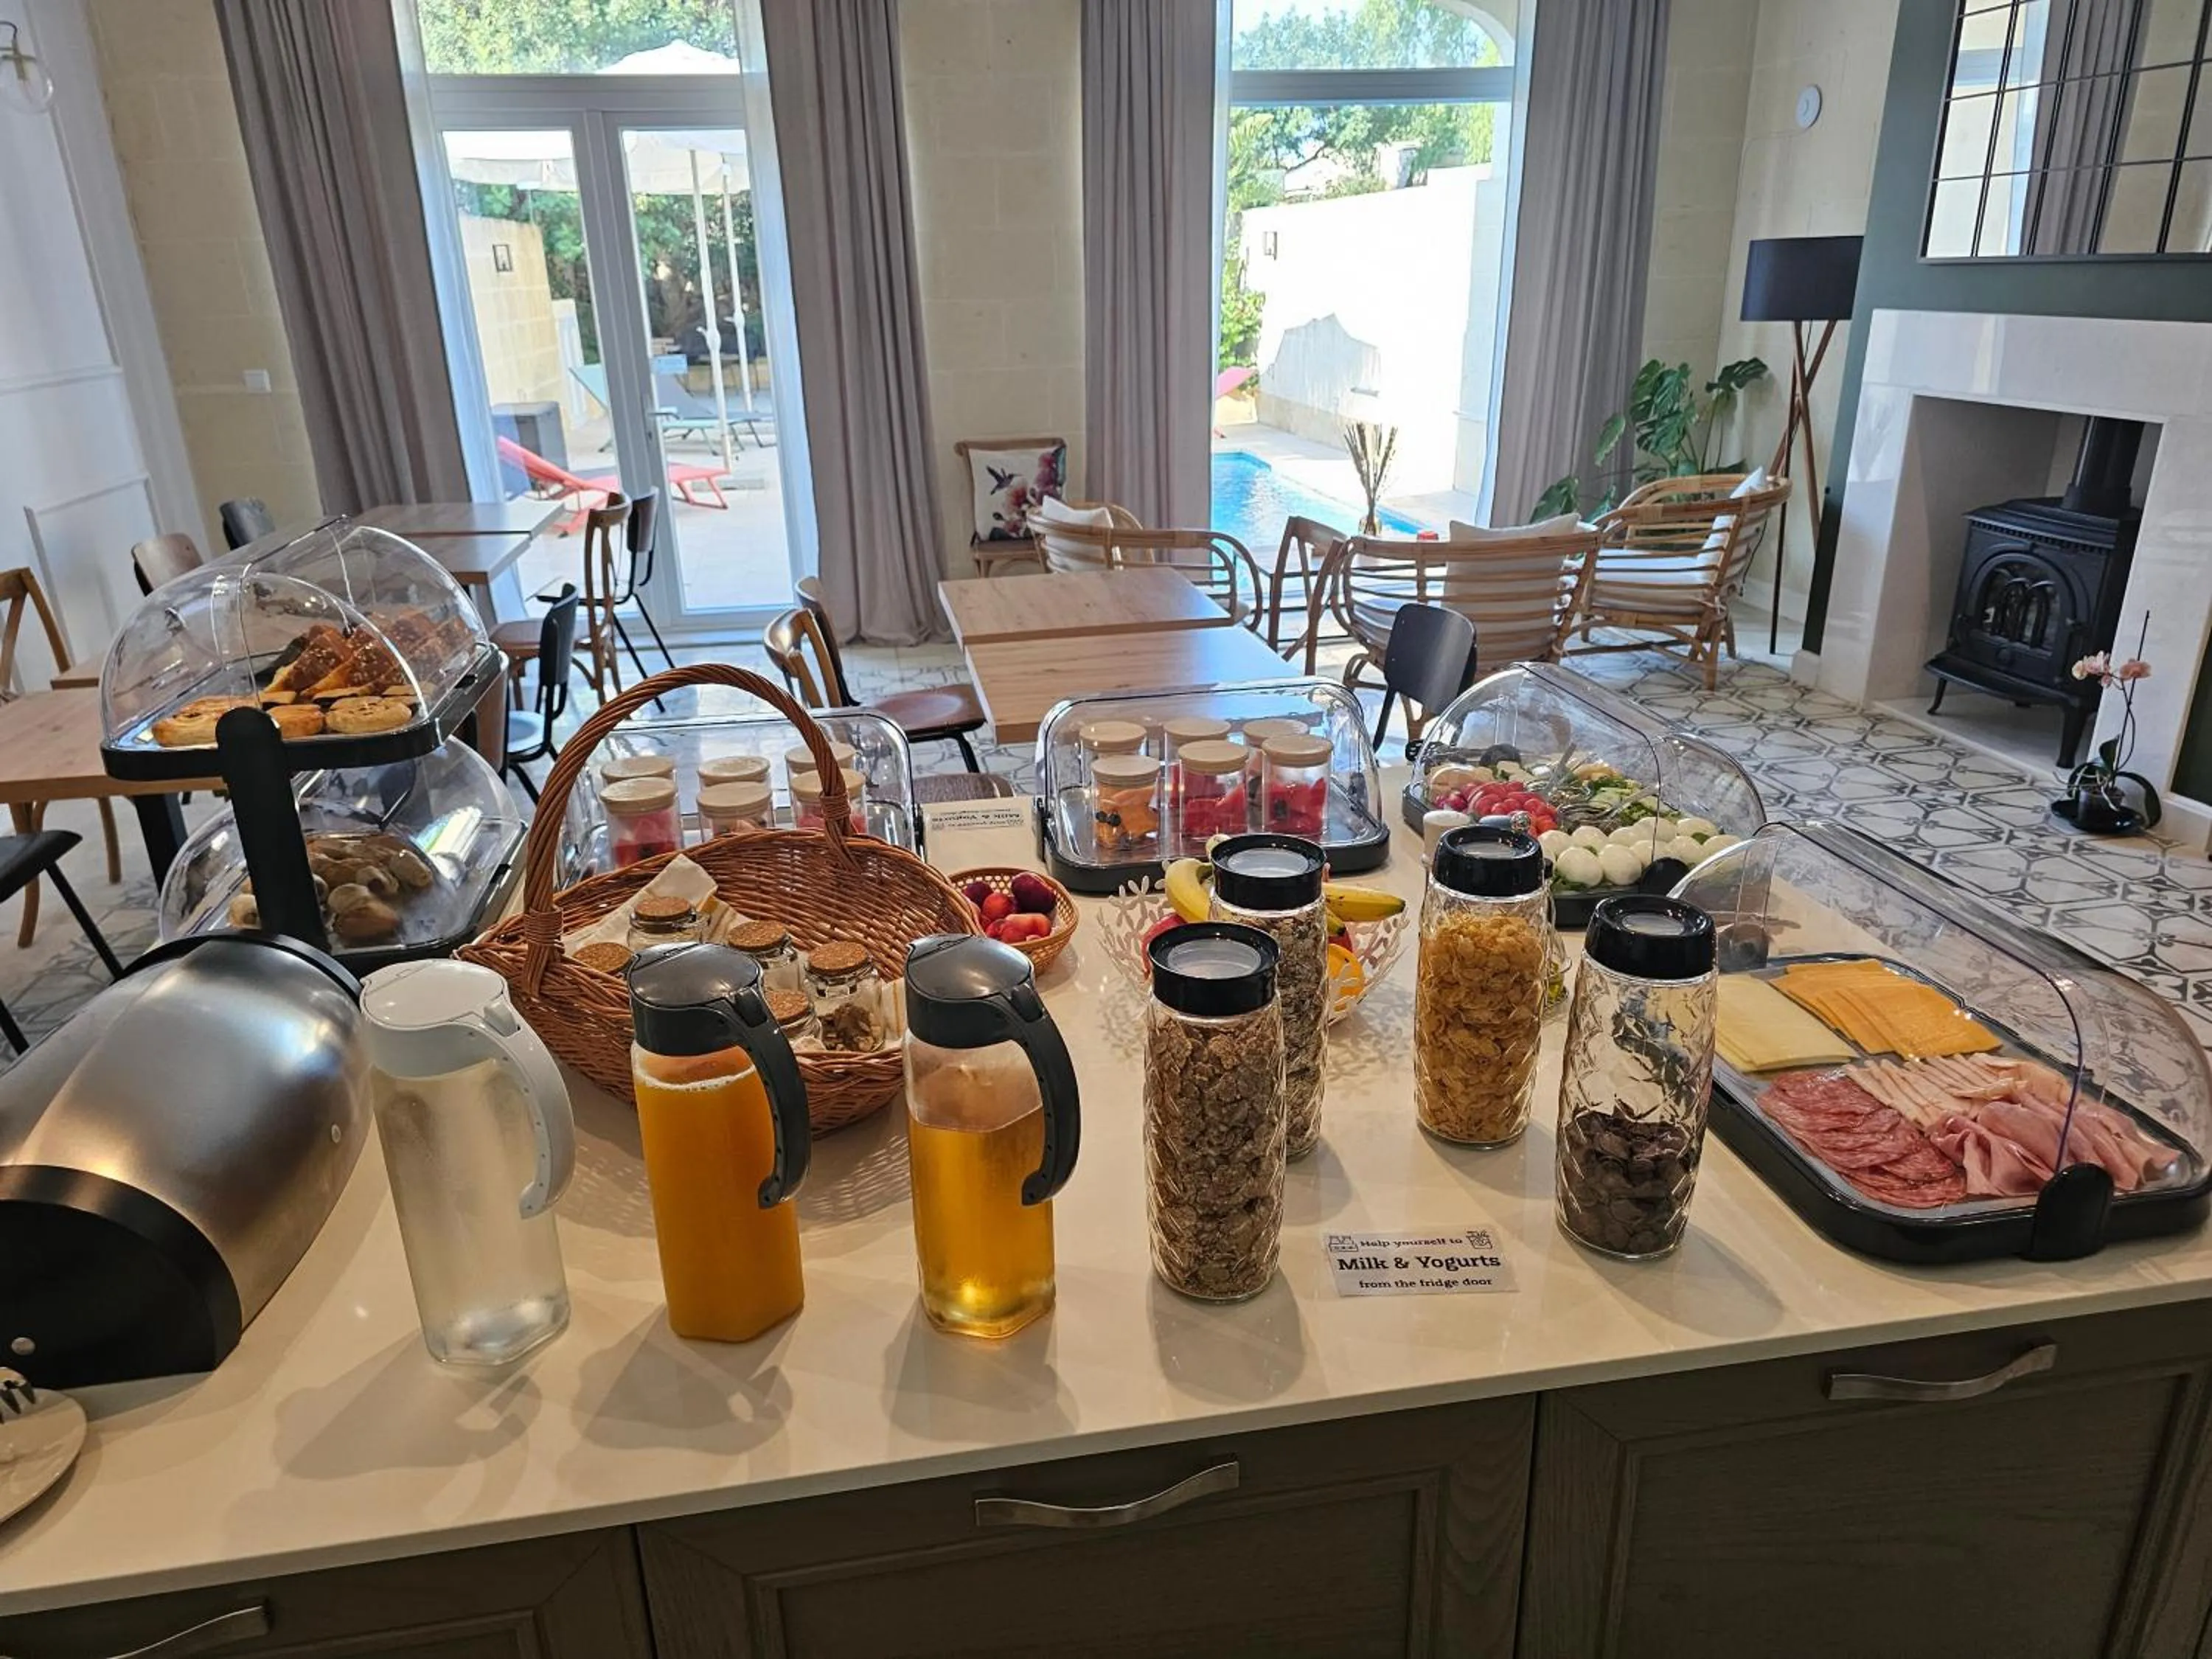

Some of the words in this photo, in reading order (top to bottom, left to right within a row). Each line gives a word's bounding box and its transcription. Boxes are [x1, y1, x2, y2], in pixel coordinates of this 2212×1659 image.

[1360, 1239, 1390, 1248] Help
[1394, 1238, 1446, 1248] yourself
[1338, 1257, 1388, 1270] Milk
[1394, 1257, 1410, 1269] &
[1416, 1255, 1501, 1271] Yogurts
[1359, 1280, 1391, 1289] from
[1394, 1279, 1416, 1287] the
[1419, 1279, 1458, 1289] fridge
[1462, 1278, 1492, 1286] door
